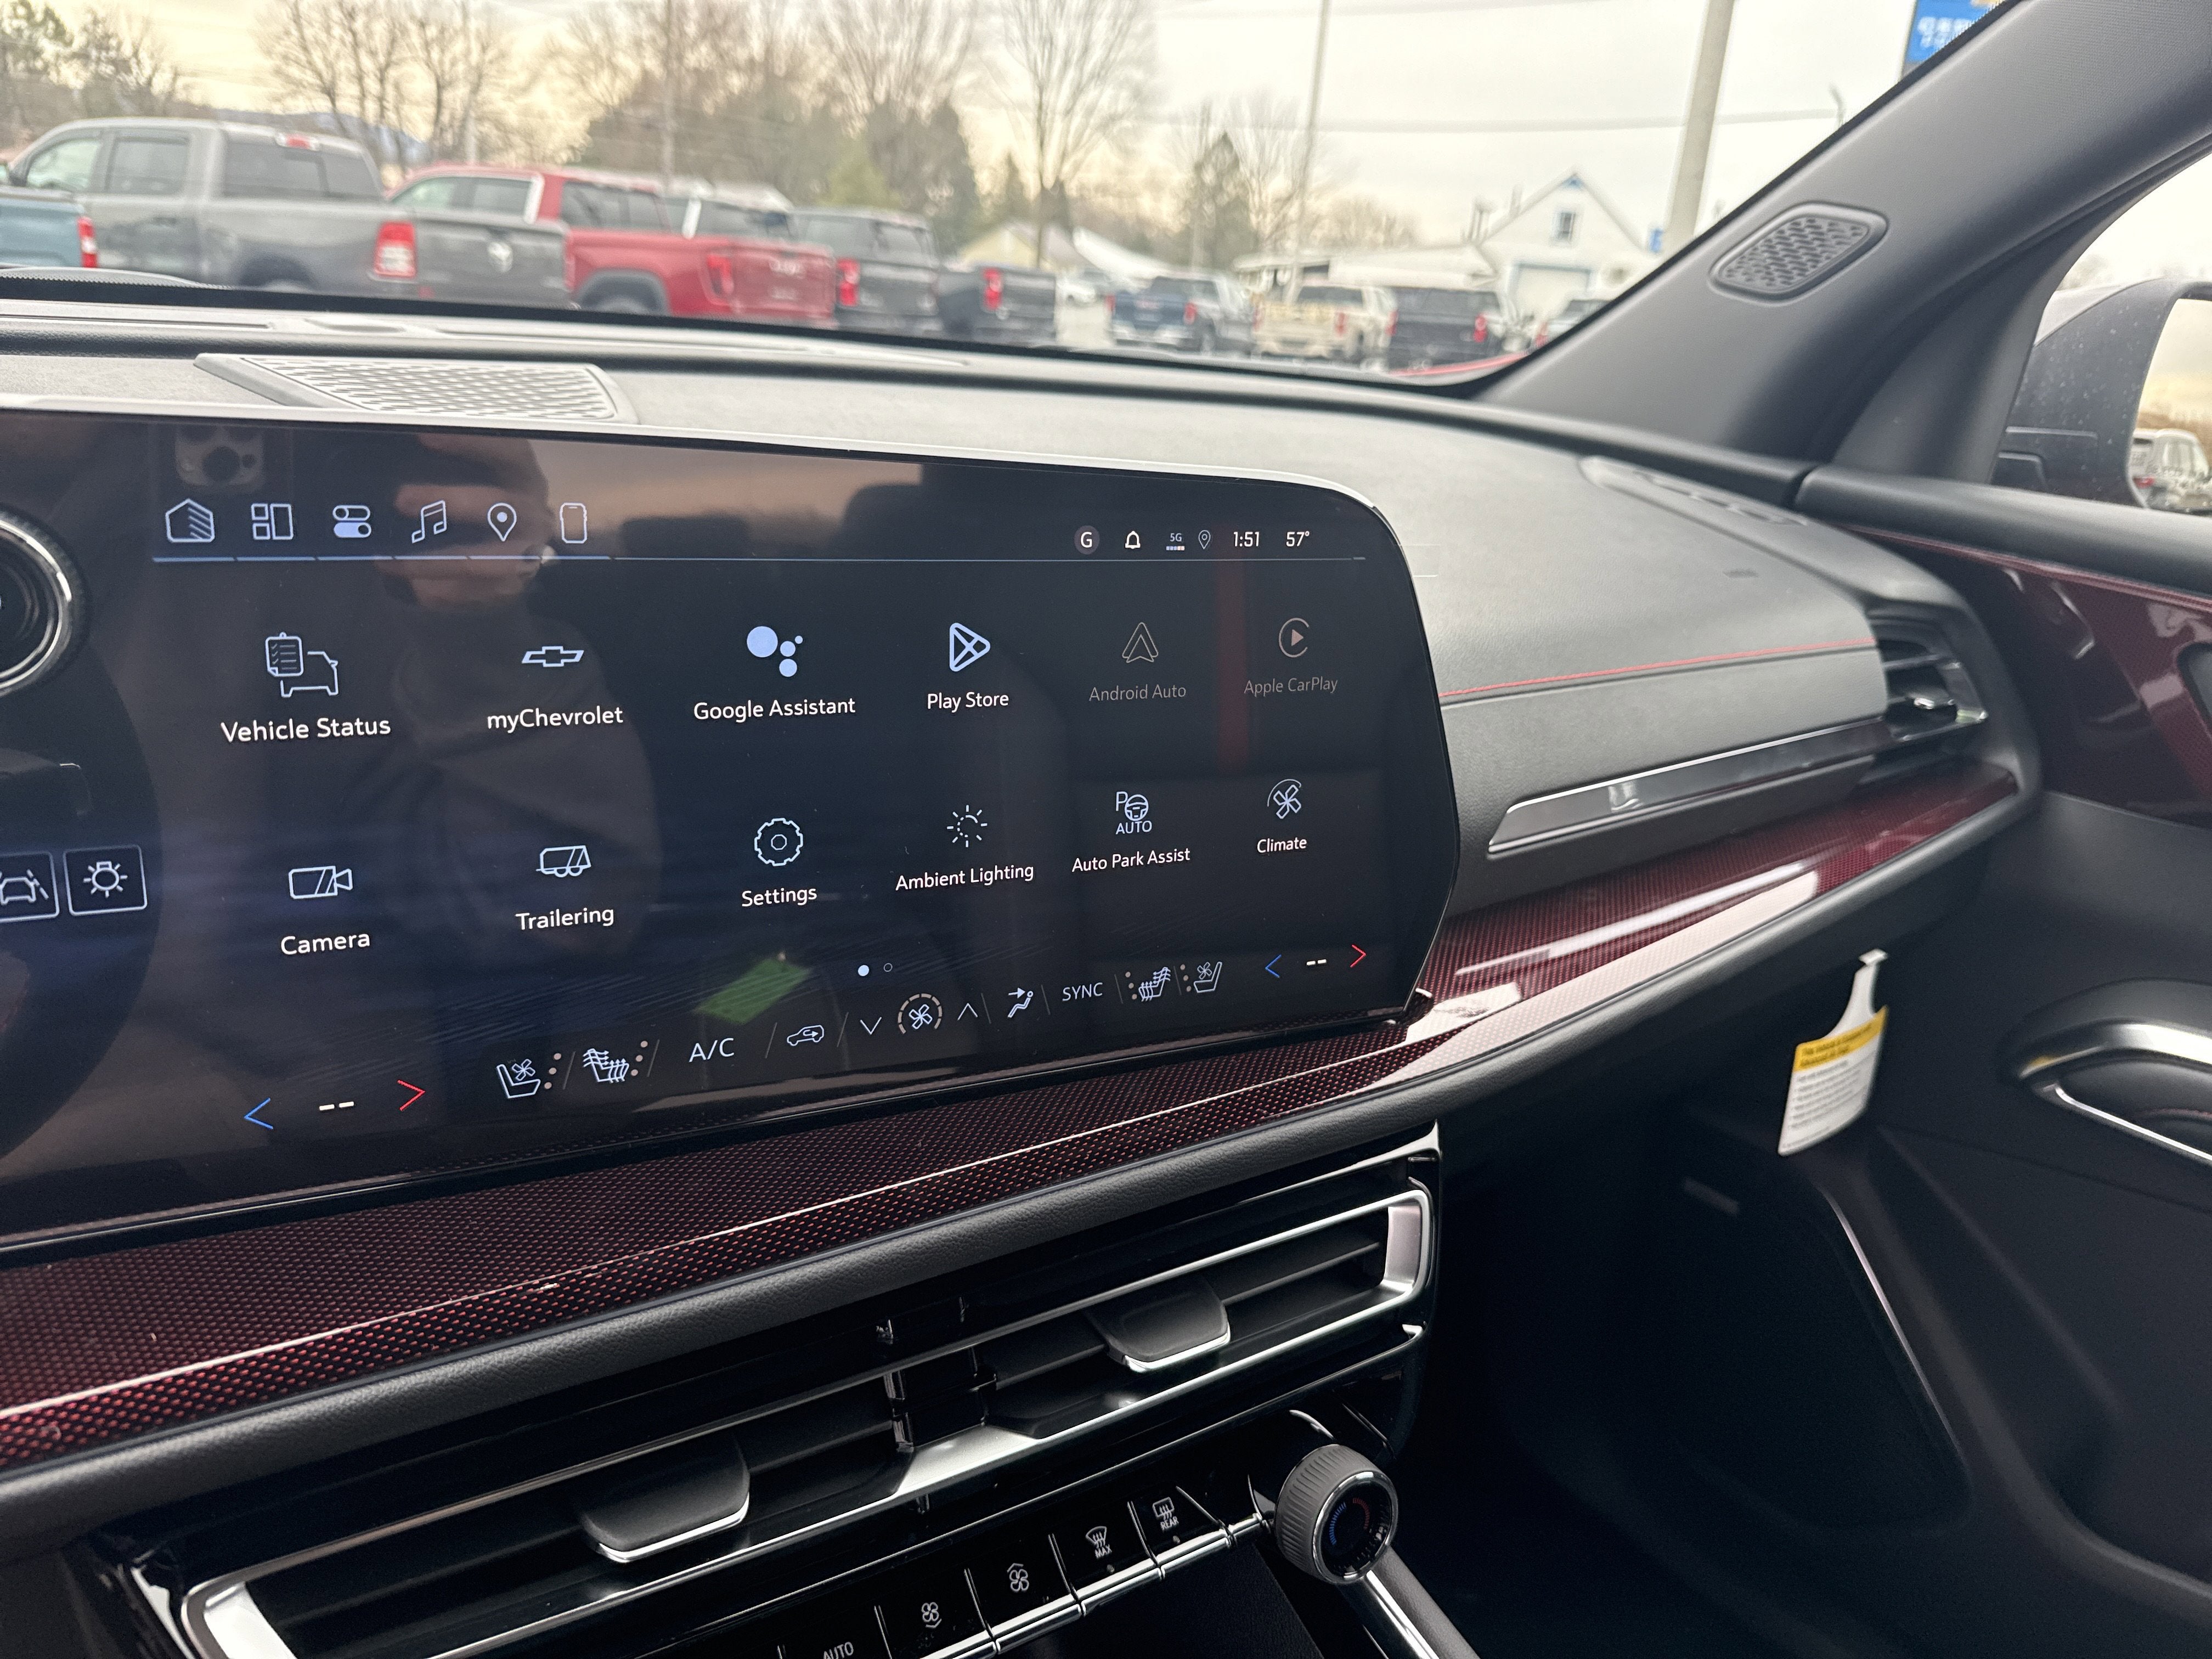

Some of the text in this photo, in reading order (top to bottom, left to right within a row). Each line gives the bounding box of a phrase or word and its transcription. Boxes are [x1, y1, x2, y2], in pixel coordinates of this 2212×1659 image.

[1080, 531, 1092, 548] G
[1170, 533, 1182, 542] 5G
[1233, 531, 1260, 547] 1:51
[1089, 684, 1186, 702] Android Auto
[1244, 676, 1338, 697] Apple CarPlay
[693, 698, 856, 723] Google Assistant
[928, 691, 1009, 713] Play Store
[487, 705, 624, 733] myChevrolet
[220, 718, 391, 742] Vehicle Status
[1115, 820, 1153, 835] AUTO
[1257, 837, 1307, 853] Climate
[1071, 848, 1190, 872] Auto Park Assist
[895, 865, 1034, 891] Ambient Lighting
[742, 888, 817, 907] Settings
[515, 907, 614, 930] Trailering
[281, 933, 370, 955] Camera
[1062, 982, 1103, 1001] SYNC
[689, 1037, 735, 1063] A/C
[1159, 1515, 1180, 1531] REAR
[1094, 1543, 1113, 1559] MAX
[823, 1641, 854, 1659] AUTO
